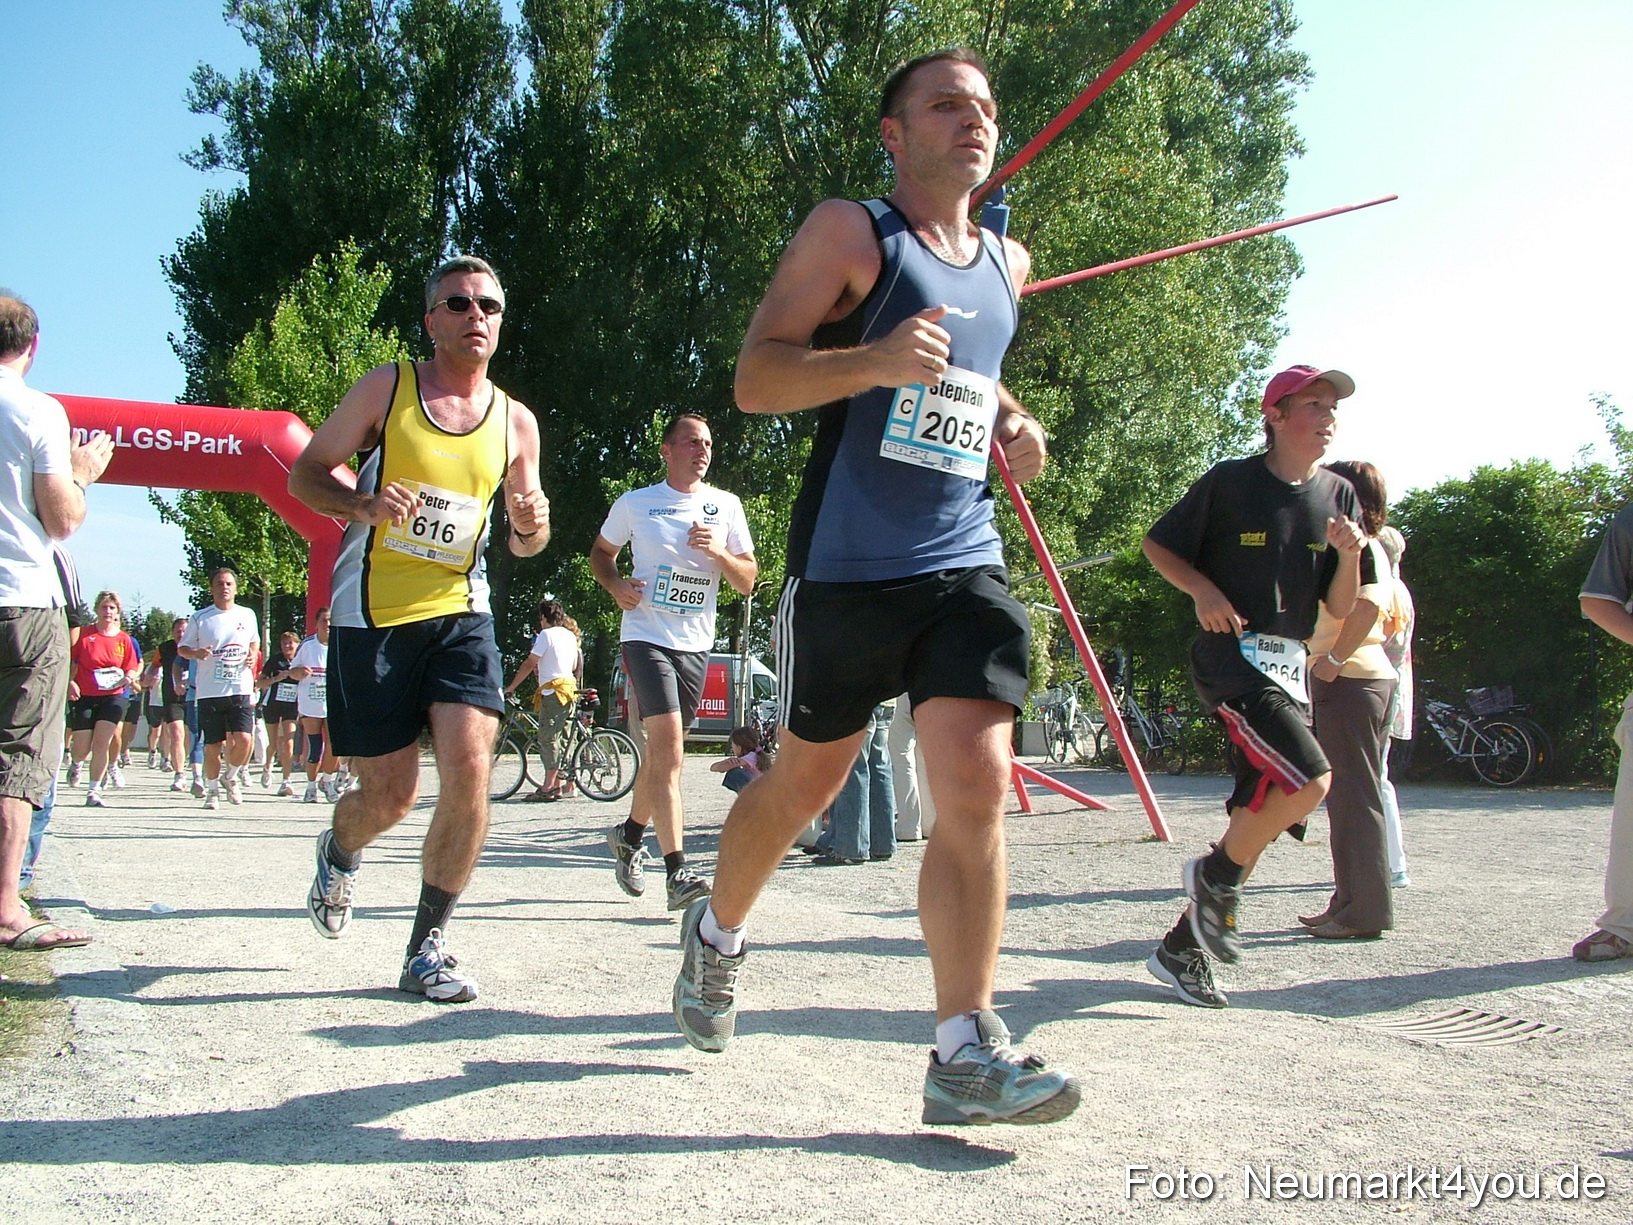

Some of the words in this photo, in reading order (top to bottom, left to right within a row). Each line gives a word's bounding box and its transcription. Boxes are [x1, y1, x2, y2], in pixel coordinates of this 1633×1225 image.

[929, 380, 983, 408] Stephan
[900, 399, 914, 415] C
[115, 426, 243, 456] LGS-Park
[920, 411, 986, 453] 2052
[419, 491, 451, 511] Peter
[412, 515, 456, 544] 616
[658, 582, 666, 591] B
[671, 572, 711, 587] Francesco
[668, 587, 706, 606] 2669
[1257, 638, 1286, 655] Ralph
